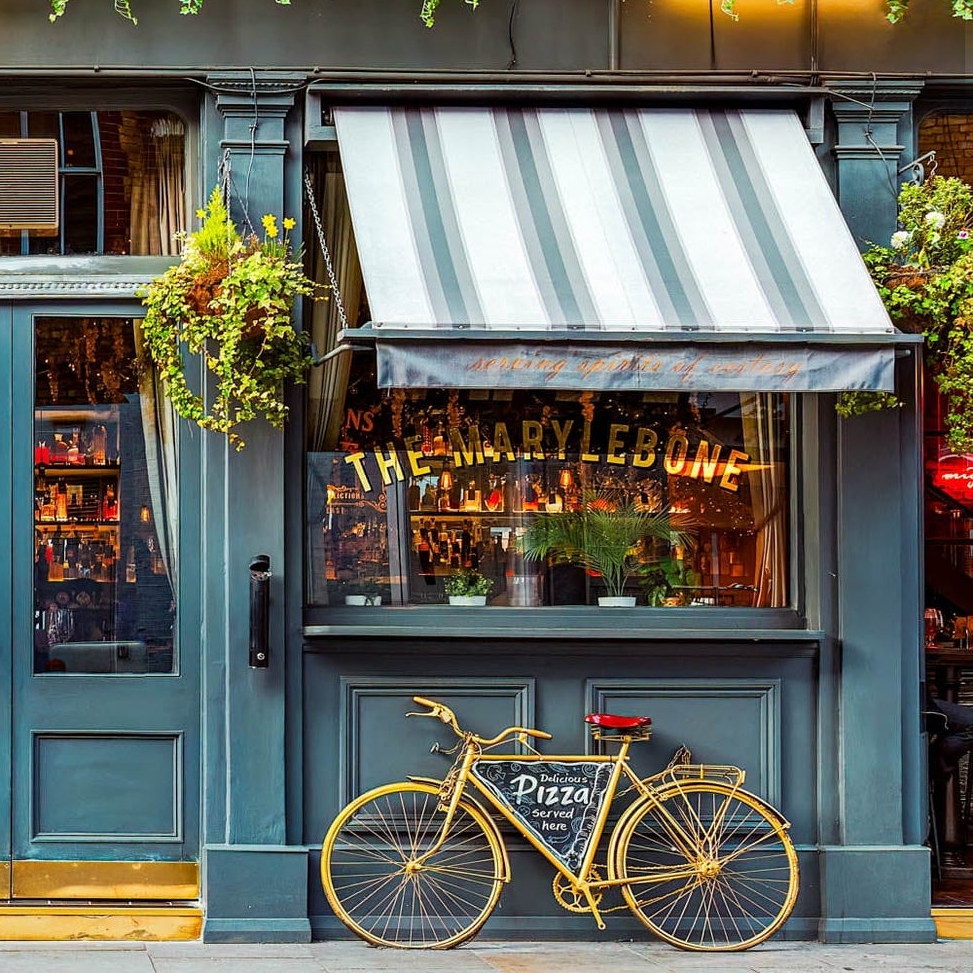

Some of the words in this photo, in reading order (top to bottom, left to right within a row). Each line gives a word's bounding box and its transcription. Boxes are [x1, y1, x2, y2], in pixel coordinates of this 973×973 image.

[672, 349, 707, 385] of
[344, 433, 432, 494] THE
[446, 419, 750, 493] MARYLEBONE
[540, 773, 588, 783] Delicious
[510, 774, 590, 806] Pizza
[532, 805, 575, 819] served
[542, 821, 568, 831] here
